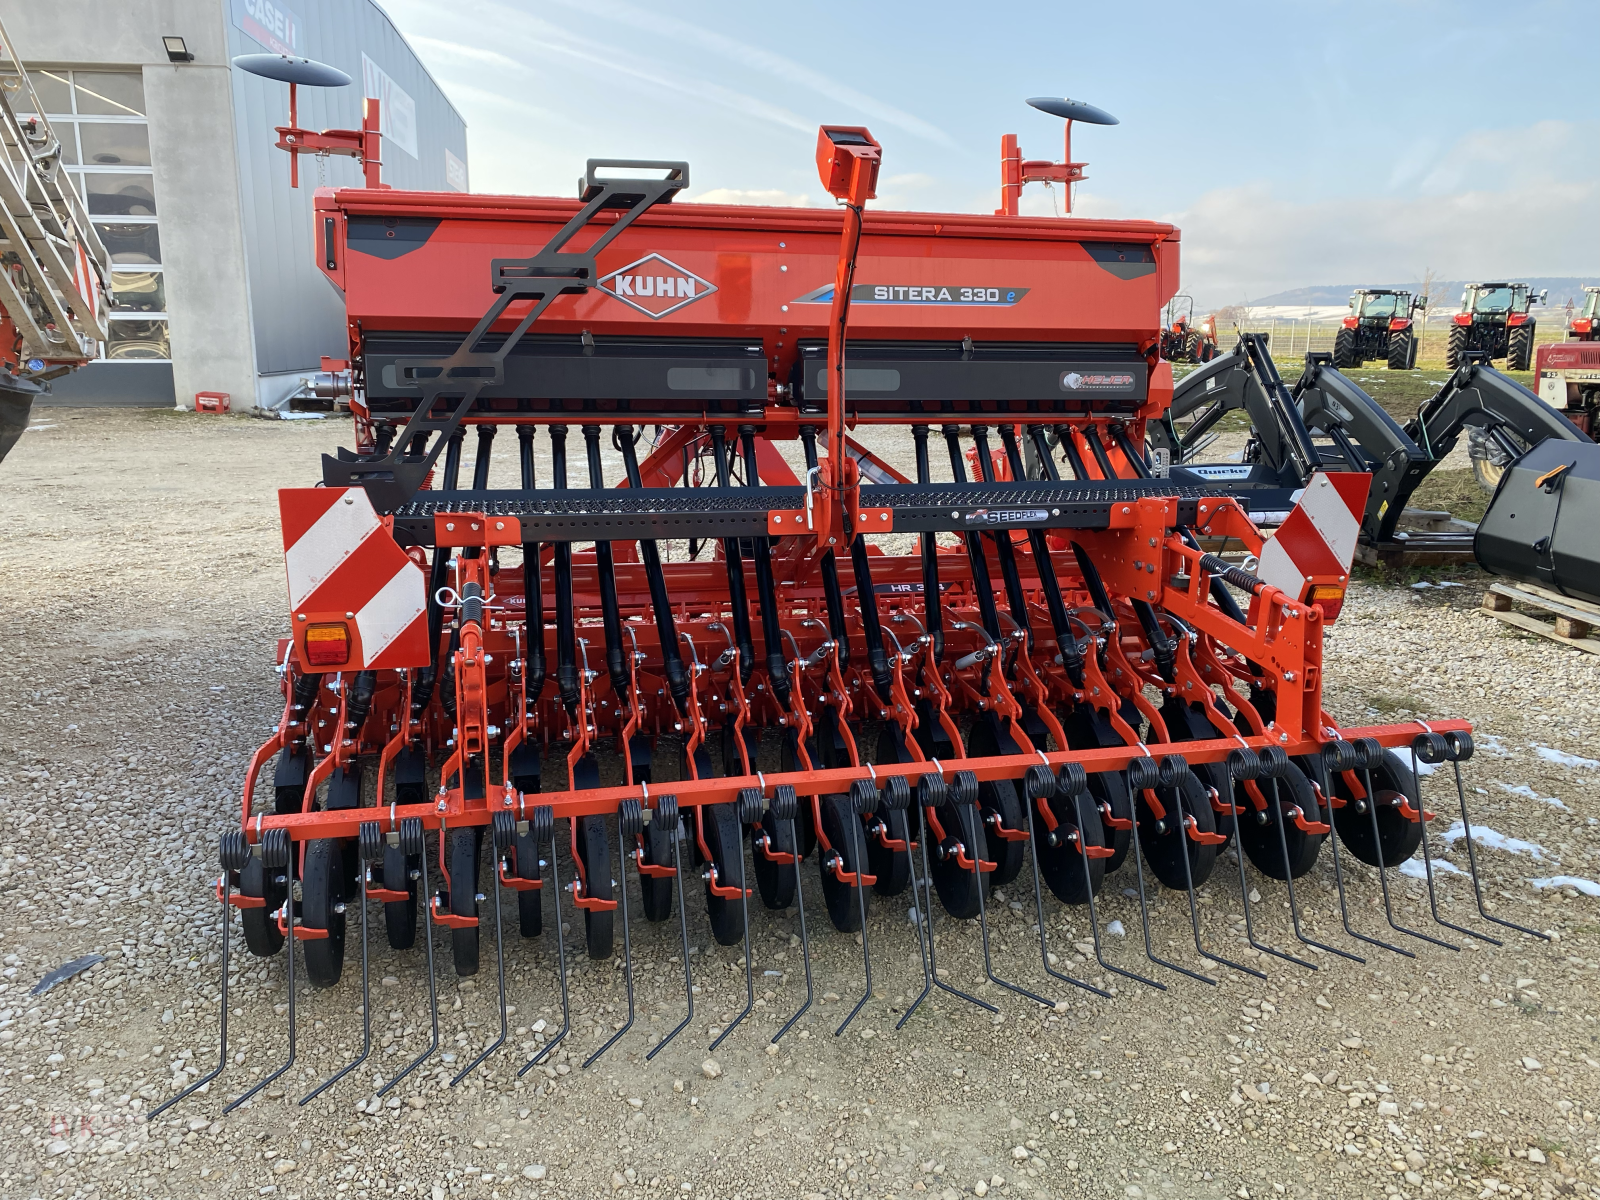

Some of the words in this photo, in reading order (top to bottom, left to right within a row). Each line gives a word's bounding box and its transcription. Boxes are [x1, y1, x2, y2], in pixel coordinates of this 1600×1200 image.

[244, 0, 284, 40] CASE
[615, 274, 696, 298] KUHN
[874, 286, 953, 301] SITERA
[960, 288, 999, 302] 330
[1006, 291, 1016, 302] e
[1081, 375, 1132, 385] HELICA
[891, 584, 913, 592] HR
[916, 583, 945, 591] 34
